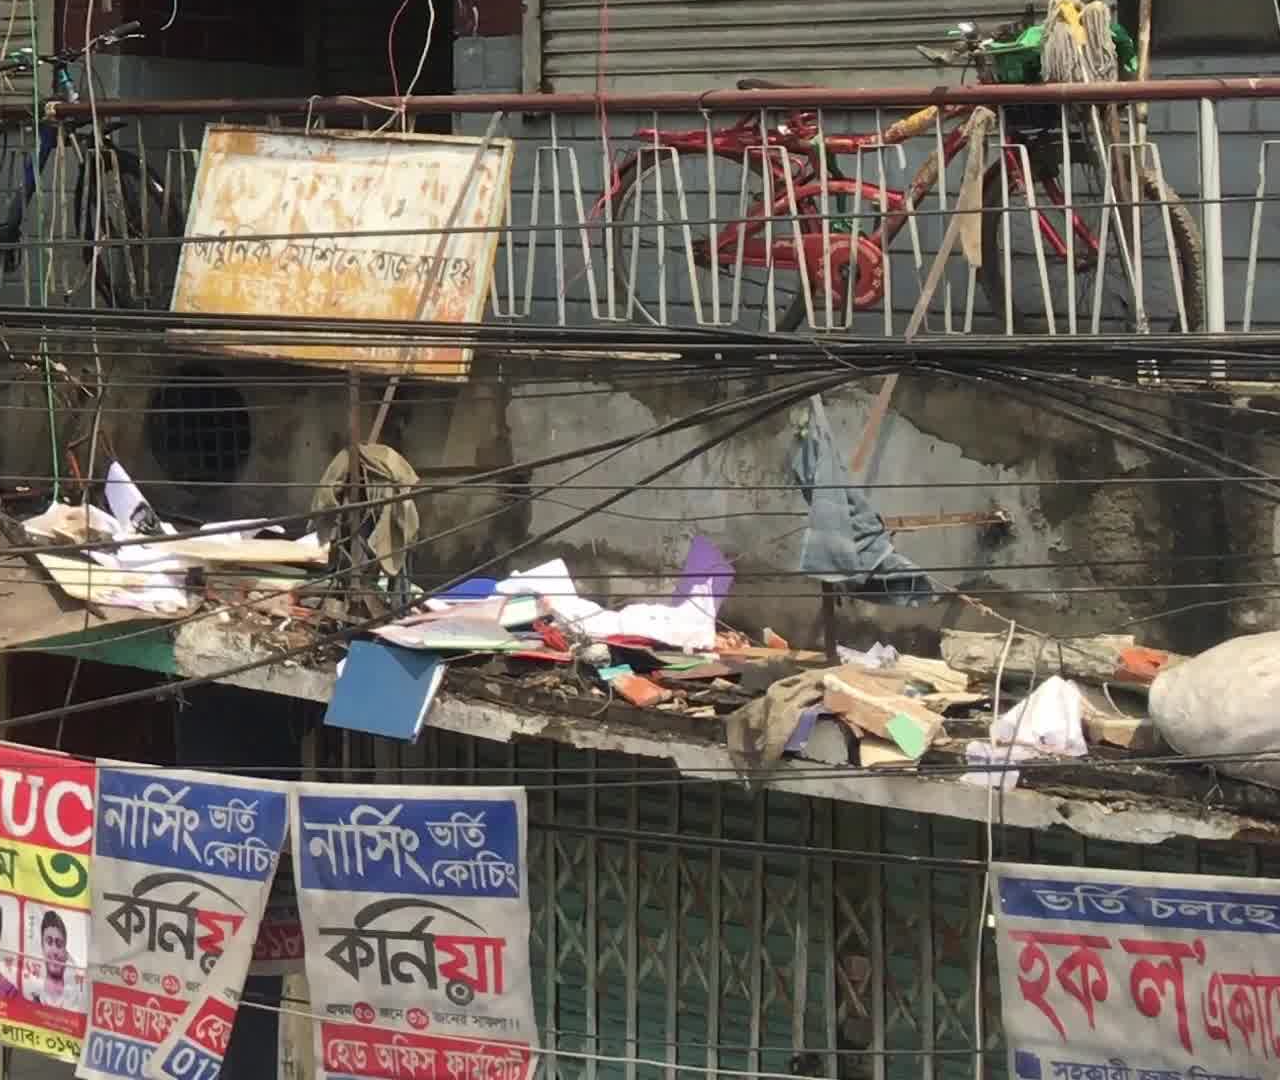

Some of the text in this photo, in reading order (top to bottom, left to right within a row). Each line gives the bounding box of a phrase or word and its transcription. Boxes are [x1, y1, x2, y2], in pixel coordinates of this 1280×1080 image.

[0, 768, 94, 848] UC
[101, 782, 259, 865] নার্সিং ভর্তি
[303, 802, 487, 887] নার্সিং ভর্তি
[36, 852, 89, 899] ৩
[432, 849, 520, 895] কোচিং
[1031, 884, 1280, 929] ভর্তি চলছে
[95, 998, 129, 1033] হেড
[327, 1039, 369, 1072] হেড
[372, 1033, 437, 1077] অফিস
